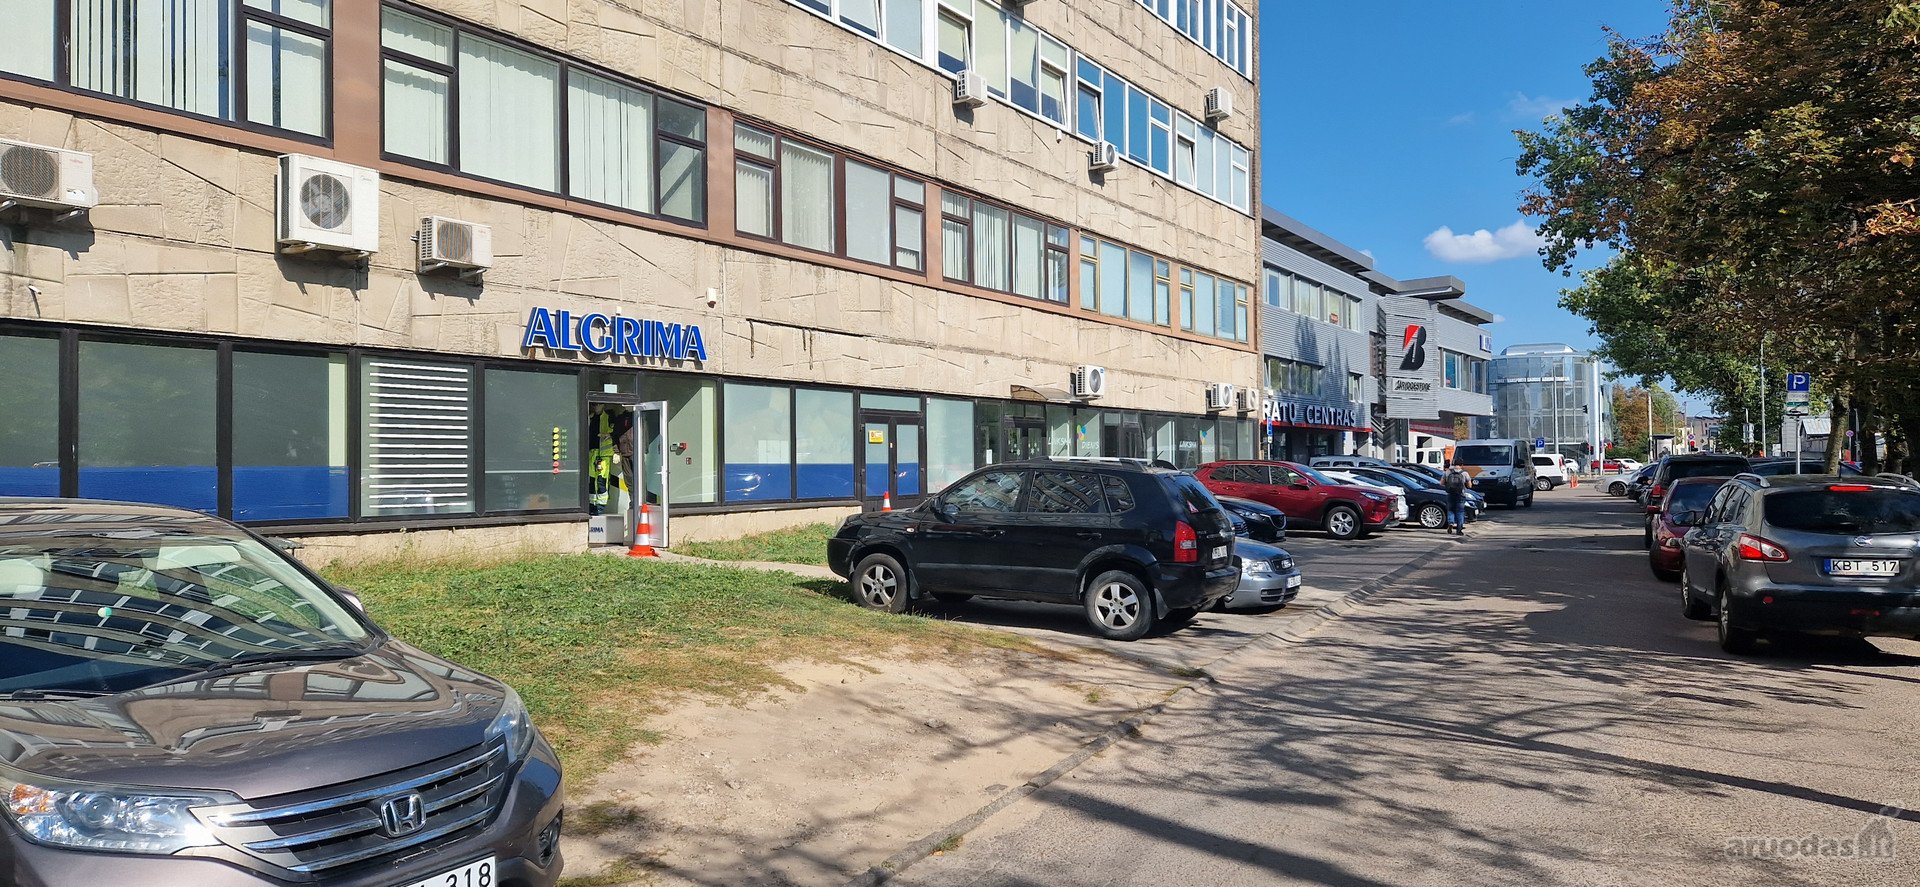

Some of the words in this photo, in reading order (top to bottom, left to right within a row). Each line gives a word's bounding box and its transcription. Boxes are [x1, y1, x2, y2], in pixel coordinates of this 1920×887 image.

[522, 306, 708, 361] ALGRIMA
[1793, 375, 1805, 389] P
[1306, 404, 1356, 427] CENTRAS
[1832, 560, 1861, 571] KBT
[1872, 561, 1896, 571] 517
